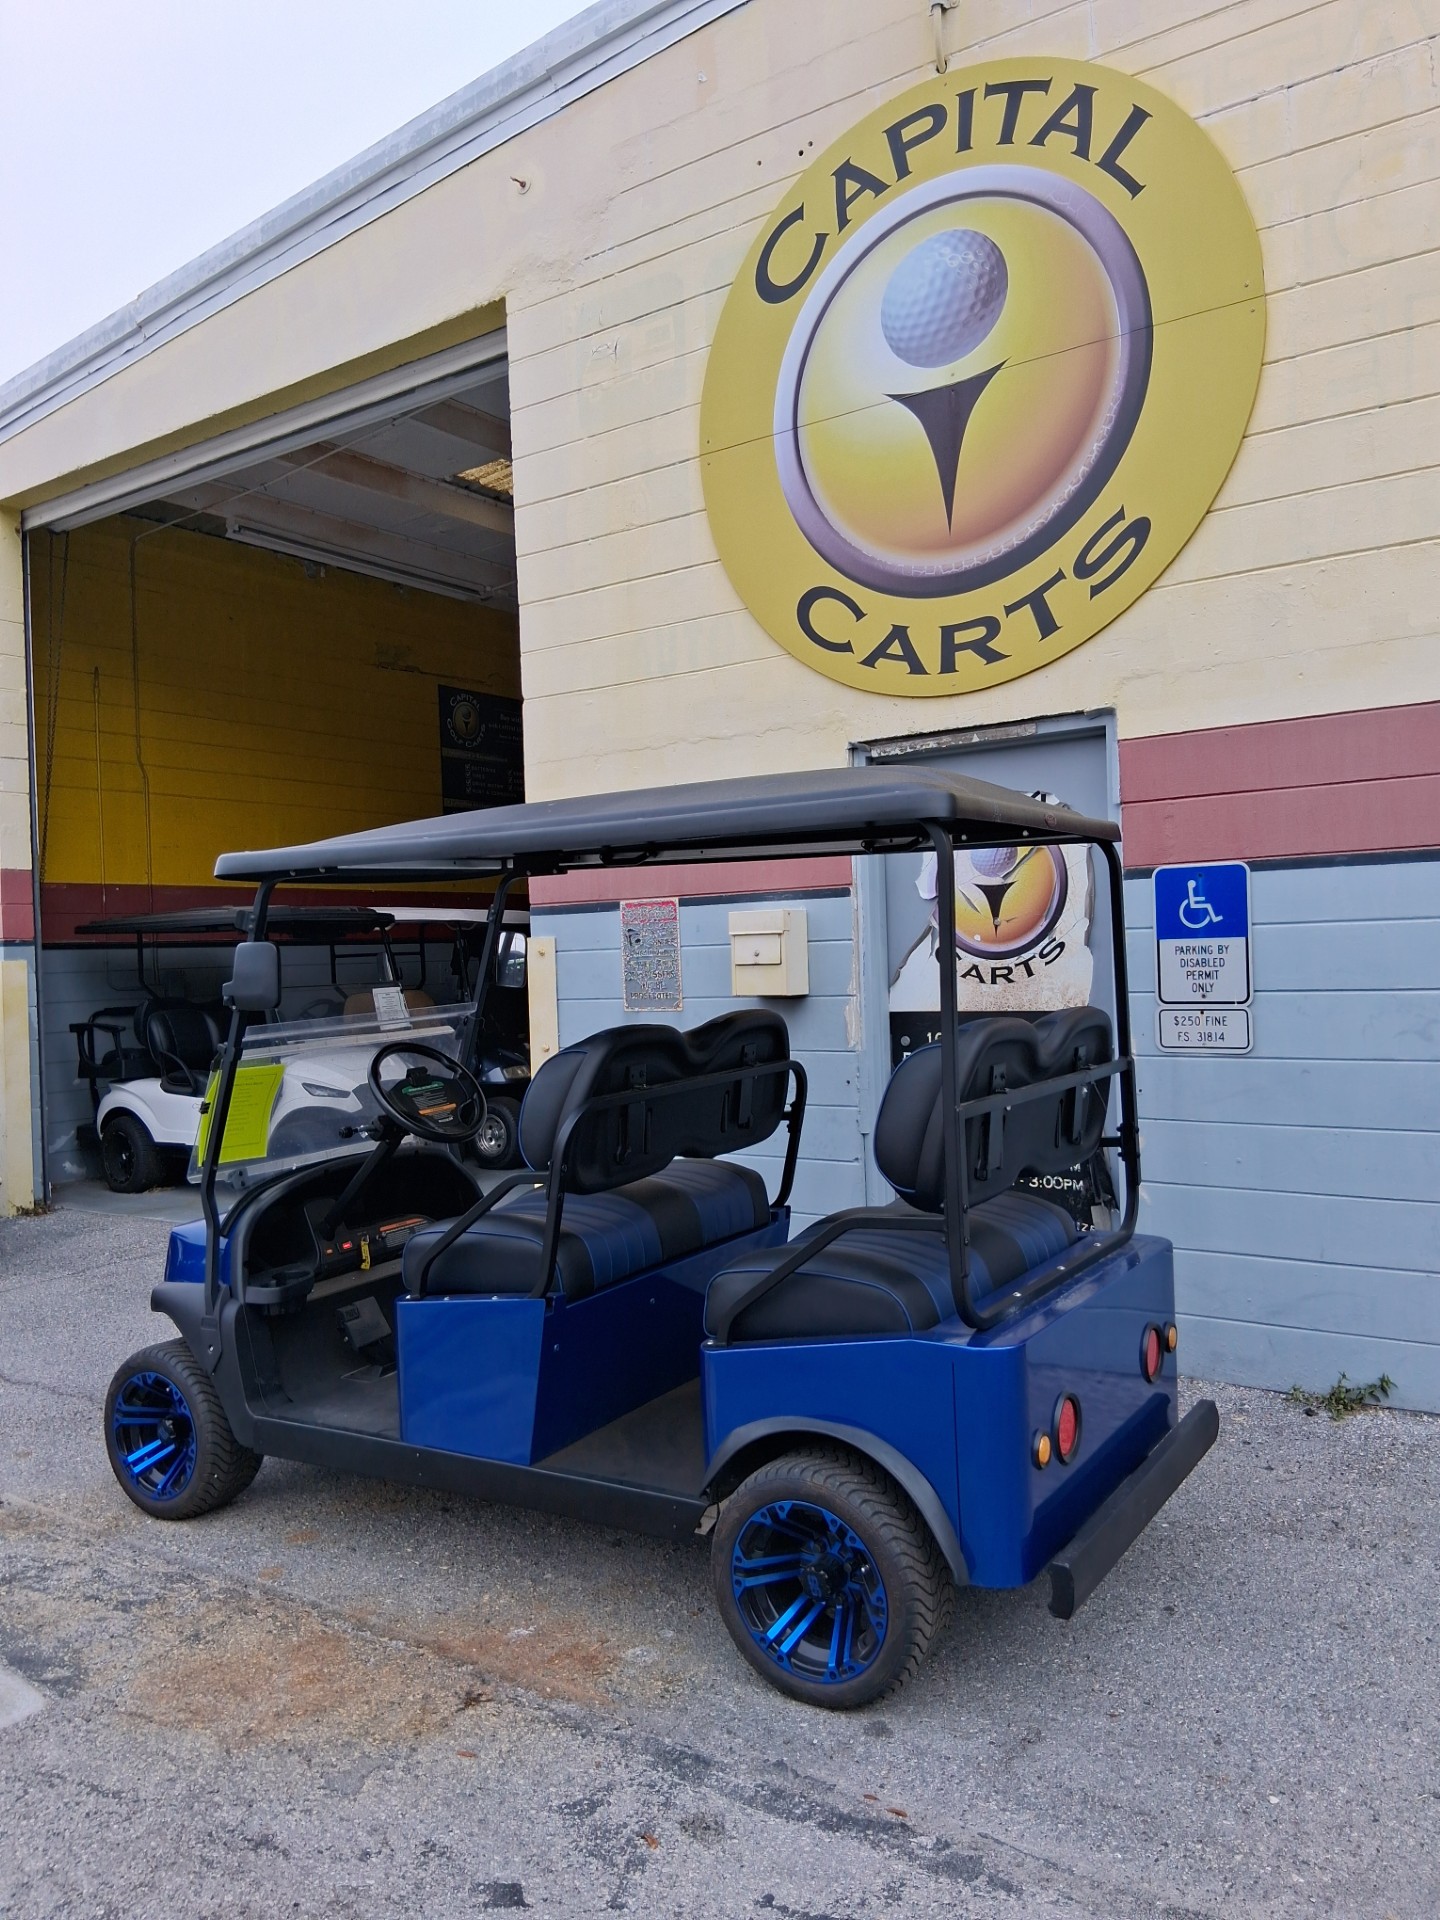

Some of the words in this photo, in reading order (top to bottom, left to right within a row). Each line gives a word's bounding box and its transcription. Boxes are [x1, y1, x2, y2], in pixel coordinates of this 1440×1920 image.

[754, 77, 1154, 305] CAPITAL
[796, 504, 1153, 676] CARTS
[449, 693, 480, 712] CAPITAL
[1175, 945, 1213, 956] PARKING
[1217, 944, 1230, 955] BY
[1180, 957, 1226, 968] DISABLED
[1186, 970, 1220, 981] PERMIT
[1191, 982, 1215, 993] ONLY
[1173, 1015, 1201, 1027] $250
[1205, 1015, 1228, 1027] FINE
[1028, 1175, 1084, 1191] 3:00PM
